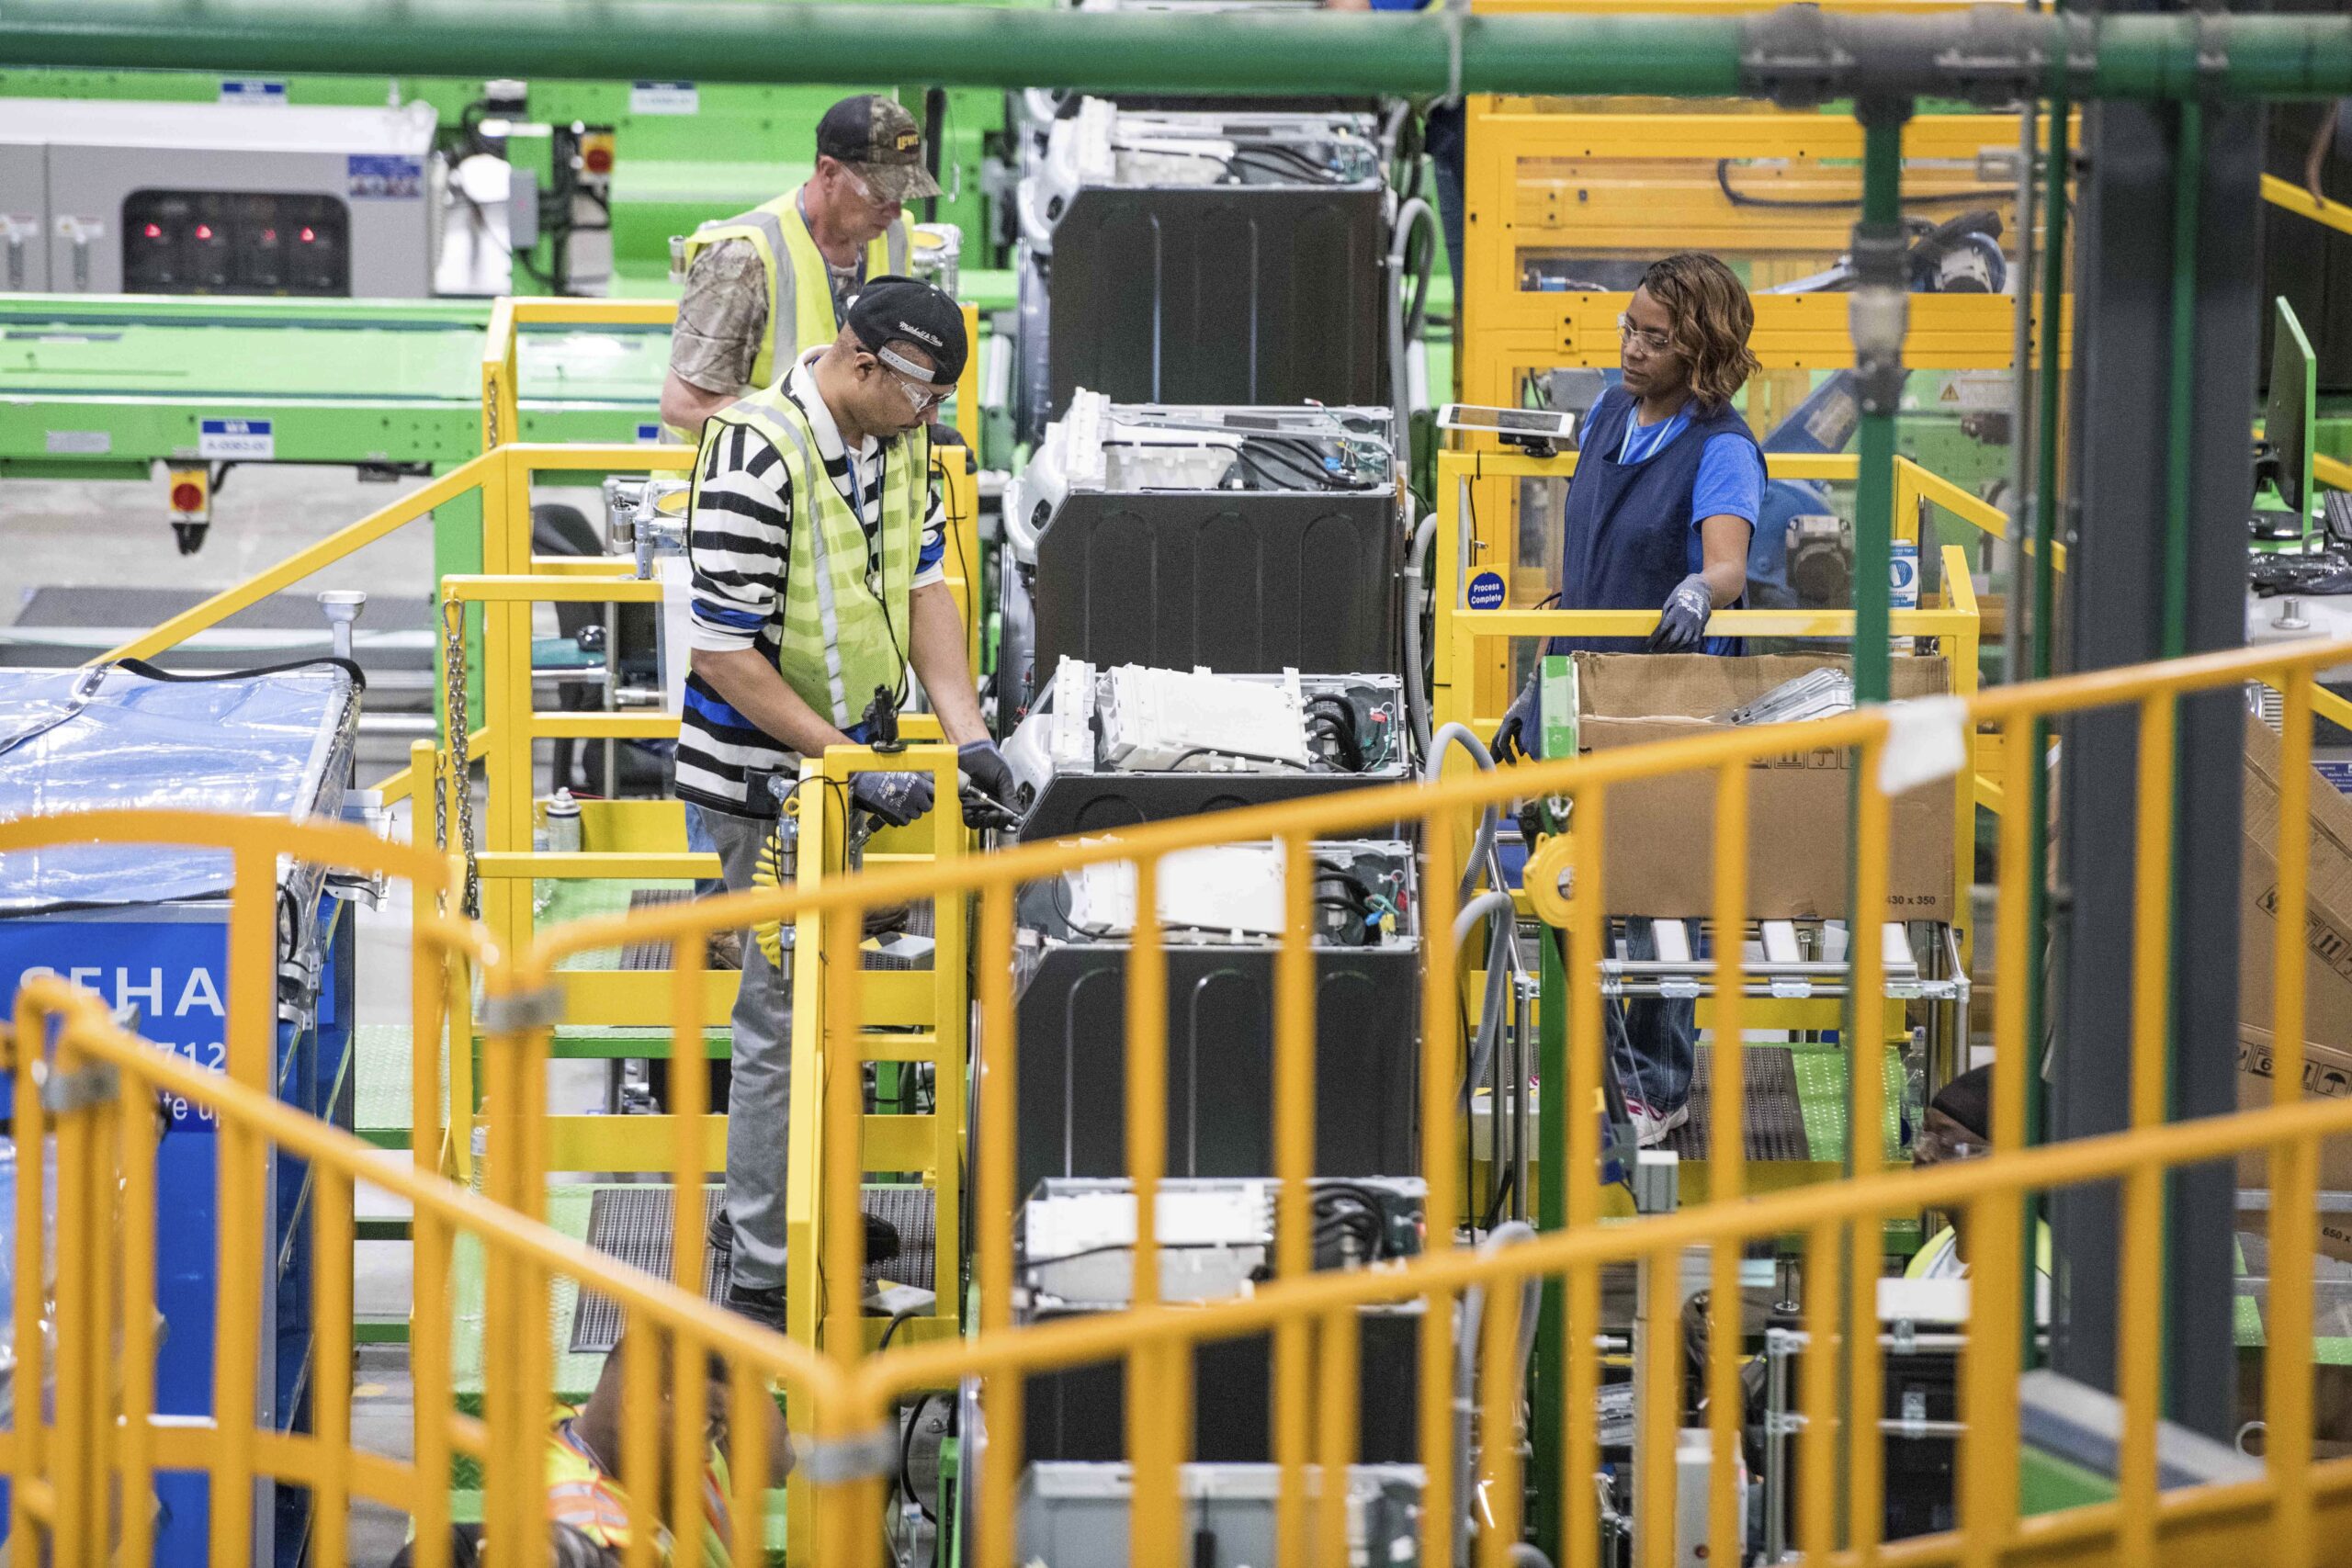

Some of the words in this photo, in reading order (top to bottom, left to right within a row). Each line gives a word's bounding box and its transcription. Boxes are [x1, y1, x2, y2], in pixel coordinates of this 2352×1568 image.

[1473, 583, 1500, 592] Process
[1471, 593, 1502, 604] Complete
[1917, 895, 1936, 905] 350
[2323, 1226, 2343, 1240] 650
